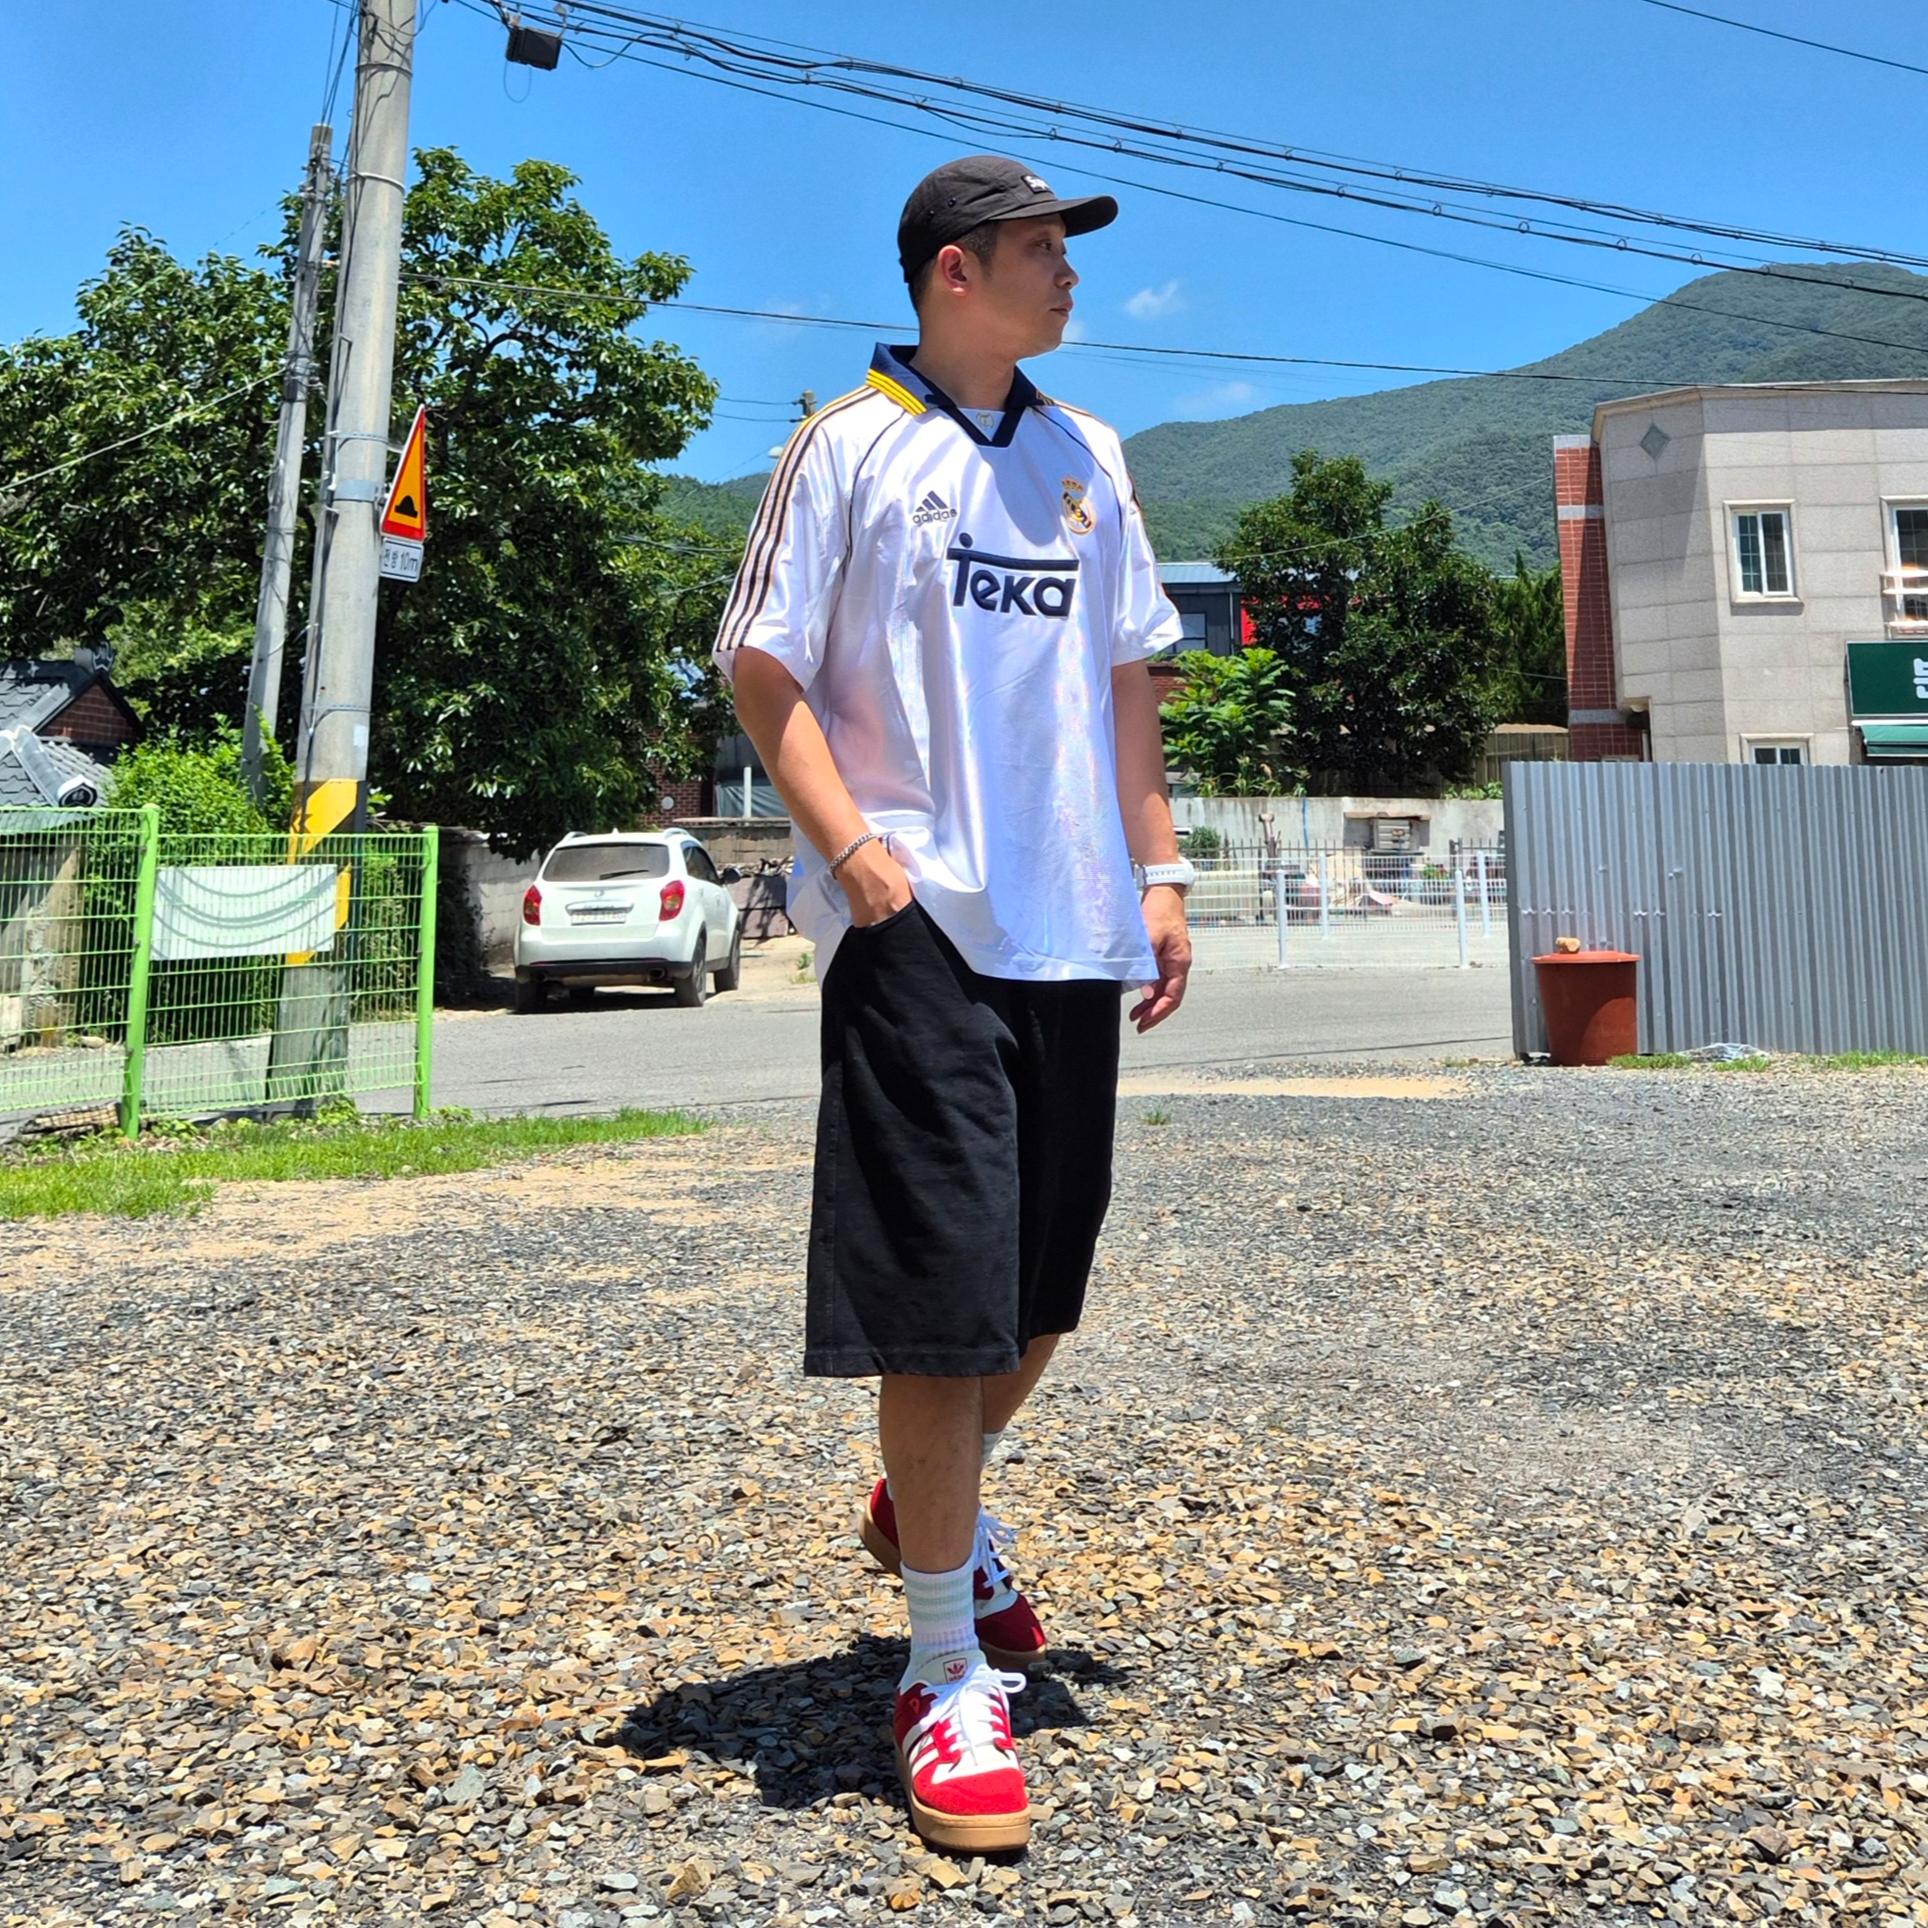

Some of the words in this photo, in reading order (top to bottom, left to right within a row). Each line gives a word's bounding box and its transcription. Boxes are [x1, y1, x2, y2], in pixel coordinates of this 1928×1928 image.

[912, 508, 958, 526] adidas
[383, 548, 399, 569] 전방
[400, 551, 419, 572] 10m
[946, 534, 1080, 617] Teka
